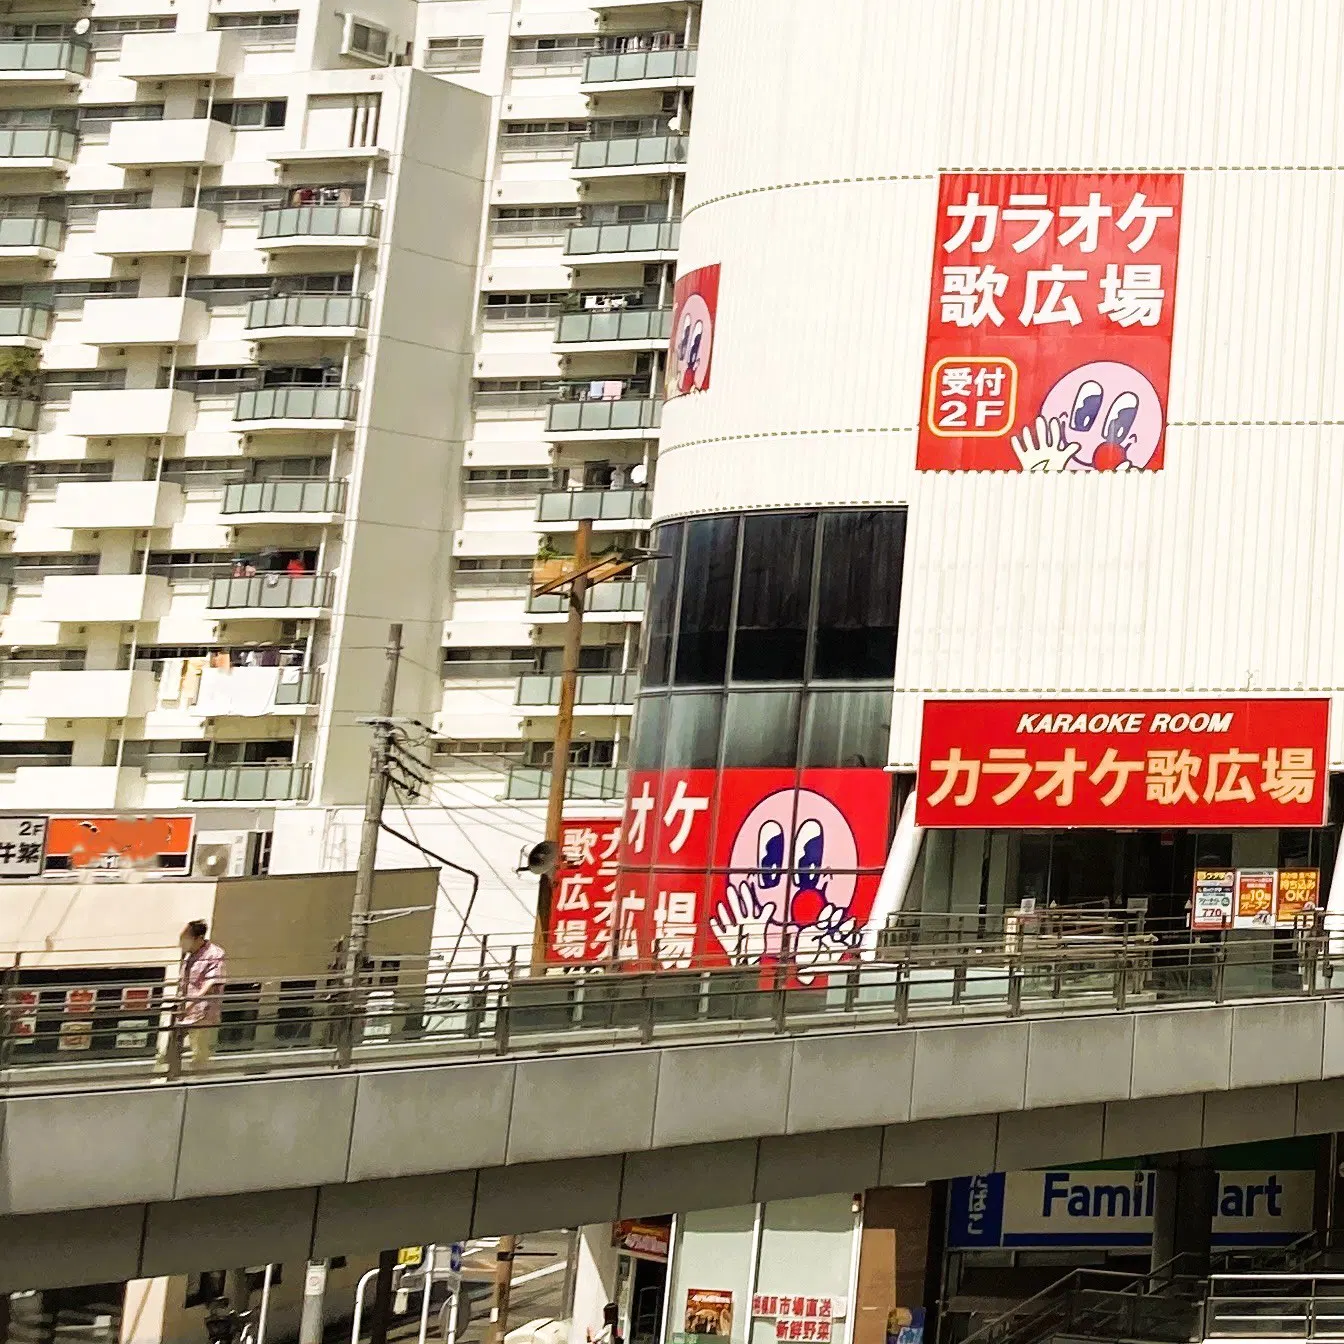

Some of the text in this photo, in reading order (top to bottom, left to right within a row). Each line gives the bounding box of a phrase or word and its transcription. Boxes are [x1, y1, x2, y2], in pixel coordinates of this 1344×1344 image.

[942, 192, 1174, 254] カラオケ
[940, 263, 1165, 329] 歌広場
[942, 367, 1006, 397] 受付
[938, 400, 1005, 428] 2F
[1016, 712, 1235, 734] KARAOKE ROOM
[927, 746, 1317, 807] カラオケ歌広場
[19, 821, 43, 836] 2F
[552, 827, 599, 959] 歌広場
[1042, 1172, 1283, 1217] Familart
